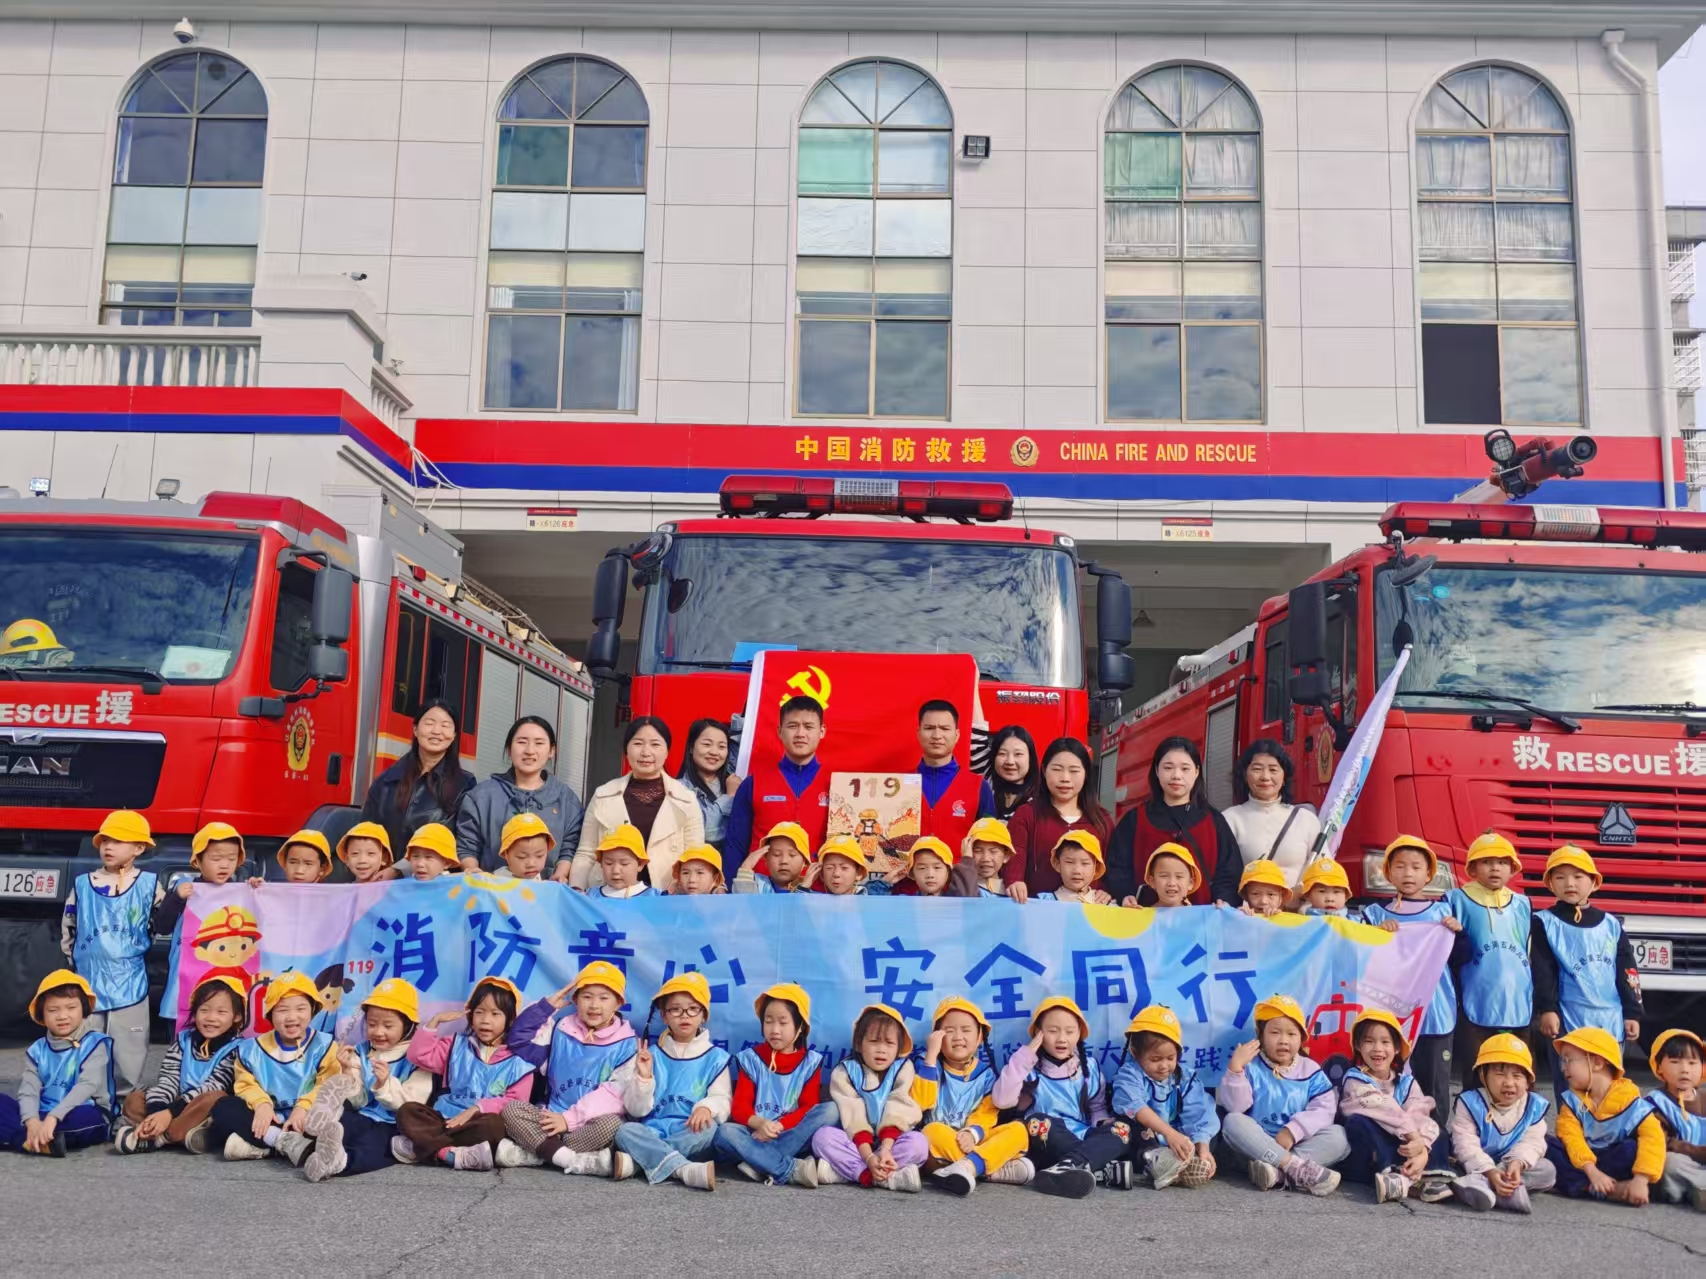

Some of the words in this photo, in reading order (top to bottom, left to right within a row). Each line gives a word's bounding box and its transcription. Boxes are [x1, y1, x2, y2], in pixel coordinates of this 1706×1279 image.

[795, 434, 987, 464] 中国消防救援
[1060, 442, 1109, 461] CHINA
[1115, 443, 1148, 461] FIRE
[1155, 443, 1189, 462] AND
[1195, 444, 1257, 463] RESCUE
[96, 689, 133, 725] 援
[0, 755, 72, 776] AN
[1512, 735, 1552, 771] 救
[1556, 751, 1672, 776] RESCUE
[848, 777, 901, 798] 119
[0, 872, 55, 894] 126应急
[348, 959, 375, 975] 119
[861, 935, 1257, 1030] 安全同行
